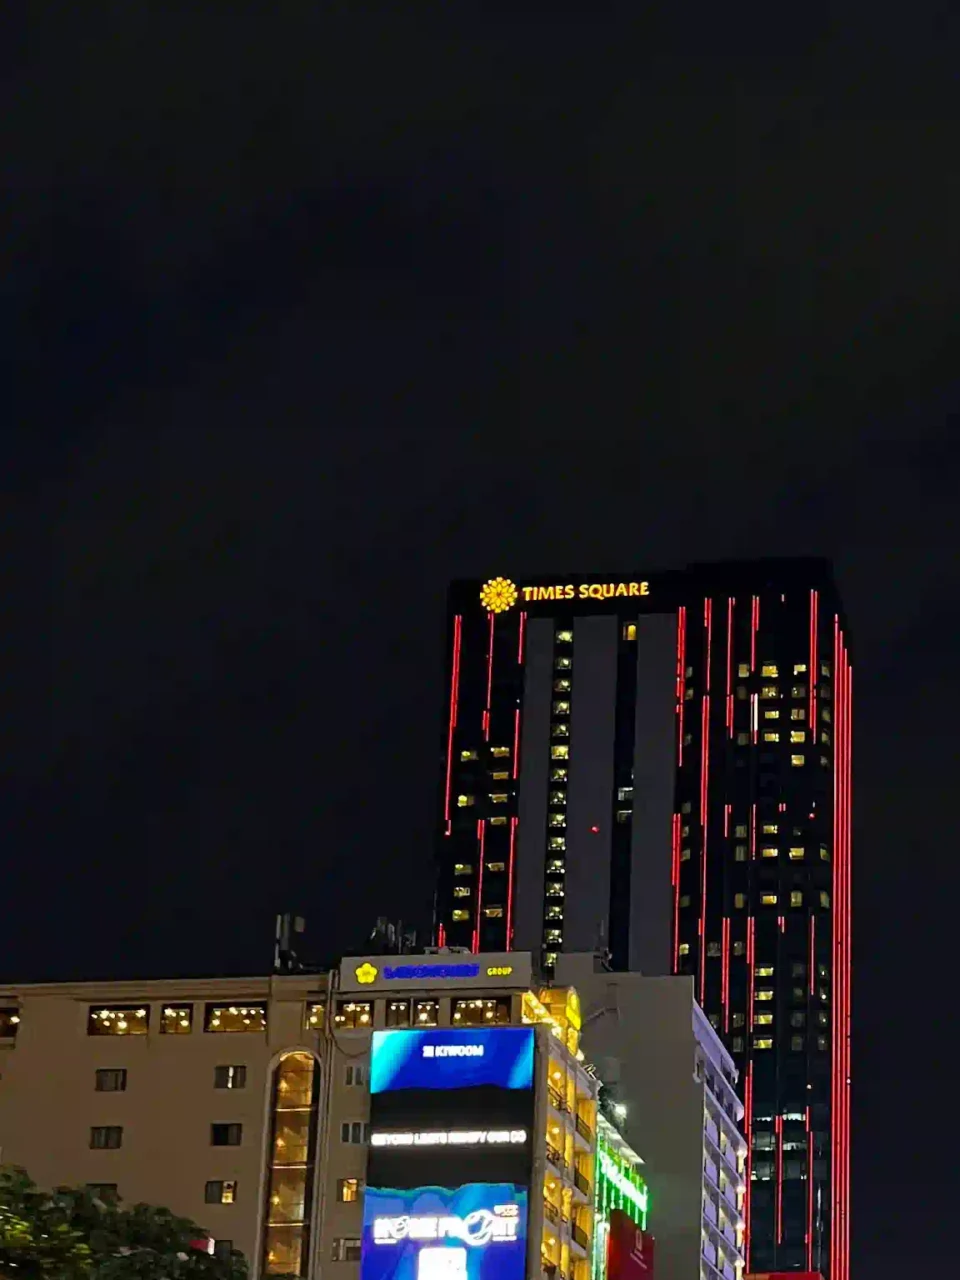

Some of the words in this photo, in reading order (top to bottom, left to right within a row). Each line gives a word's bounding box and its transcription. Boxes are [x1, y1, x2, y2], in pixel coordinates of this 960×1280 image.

[522, 583, 575, 601] TIMES
[579, 581, 650, 601] SQUARE
[487, 967, 513, 976] GROUP
